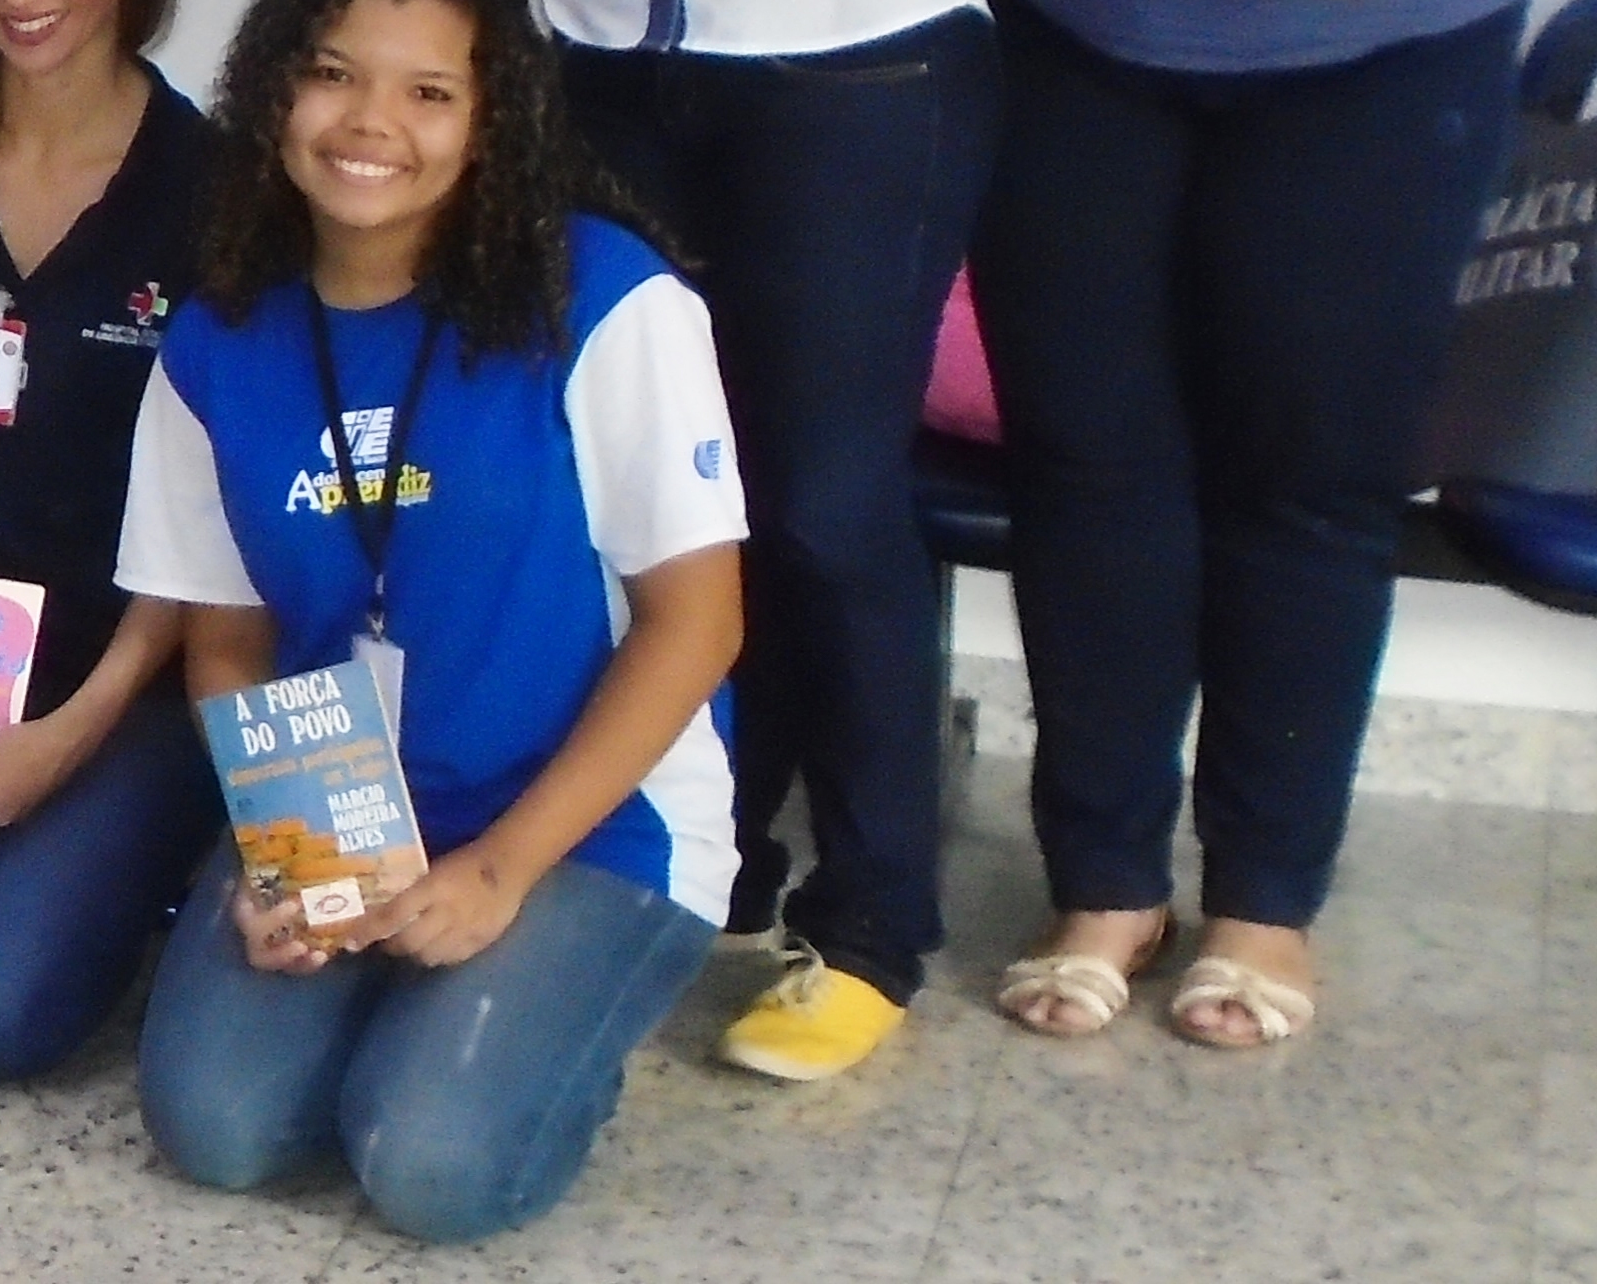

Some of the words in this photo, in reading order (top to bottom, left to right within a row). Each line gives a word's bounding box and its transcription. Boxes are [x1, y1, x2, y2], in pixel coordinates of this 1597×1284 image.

[235, 691, 253, 723] A
[264, 669, 343, 714] FORÇA
[241, 722, 276, 756] DO
[288, 704, 353, 745] POVO
[327, 783, 386, 809] MARCIO
[331, 801, 401, 833] MOREIRA
[337, 827, 386, 854] ALVES
